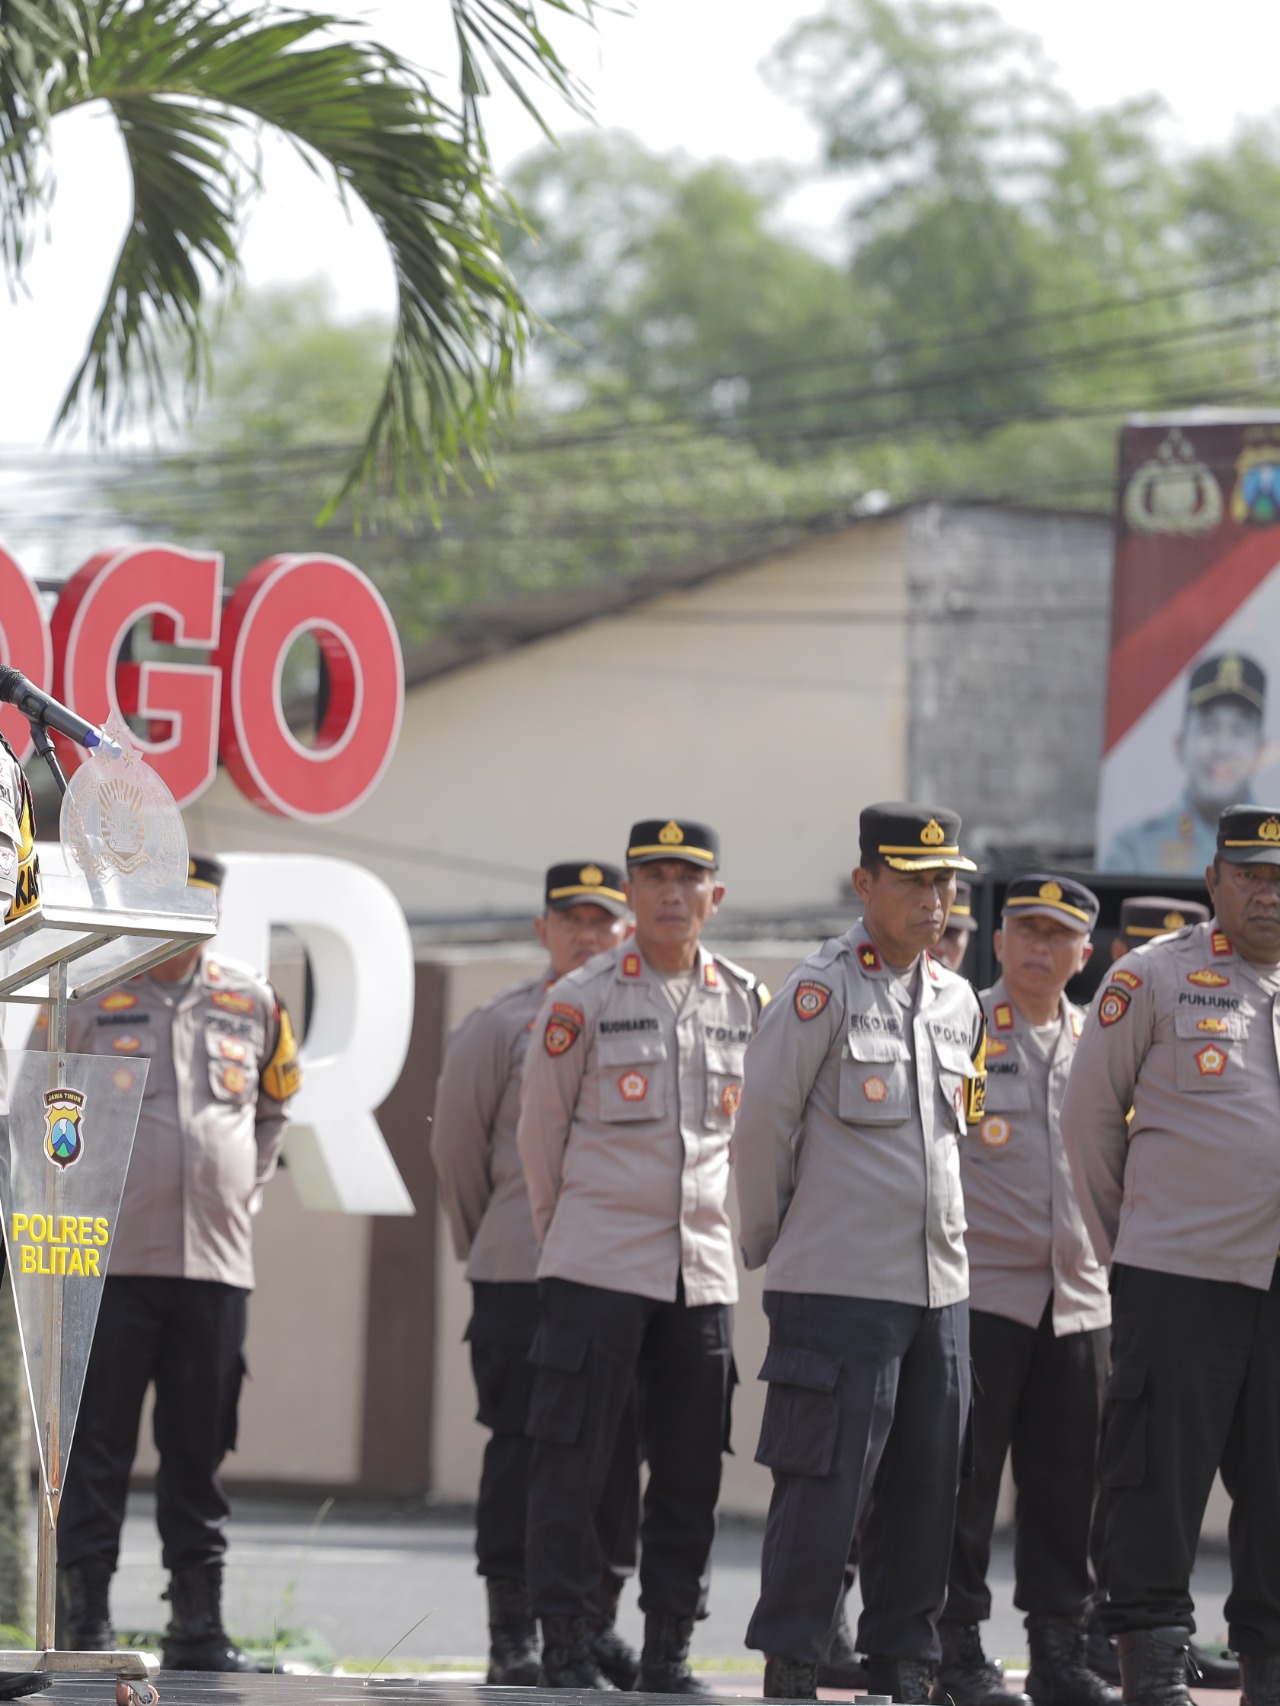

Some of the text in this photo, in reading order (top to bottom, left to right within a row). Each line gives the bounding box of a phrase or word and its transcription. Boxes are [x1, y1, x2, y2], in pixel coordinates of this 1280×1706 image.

[48, 1092, 82, 1103] JAWA TIMUR
[12, 1212, 109, 1246] POLRES
[21, 1244, 101, 1277] BLITAR
